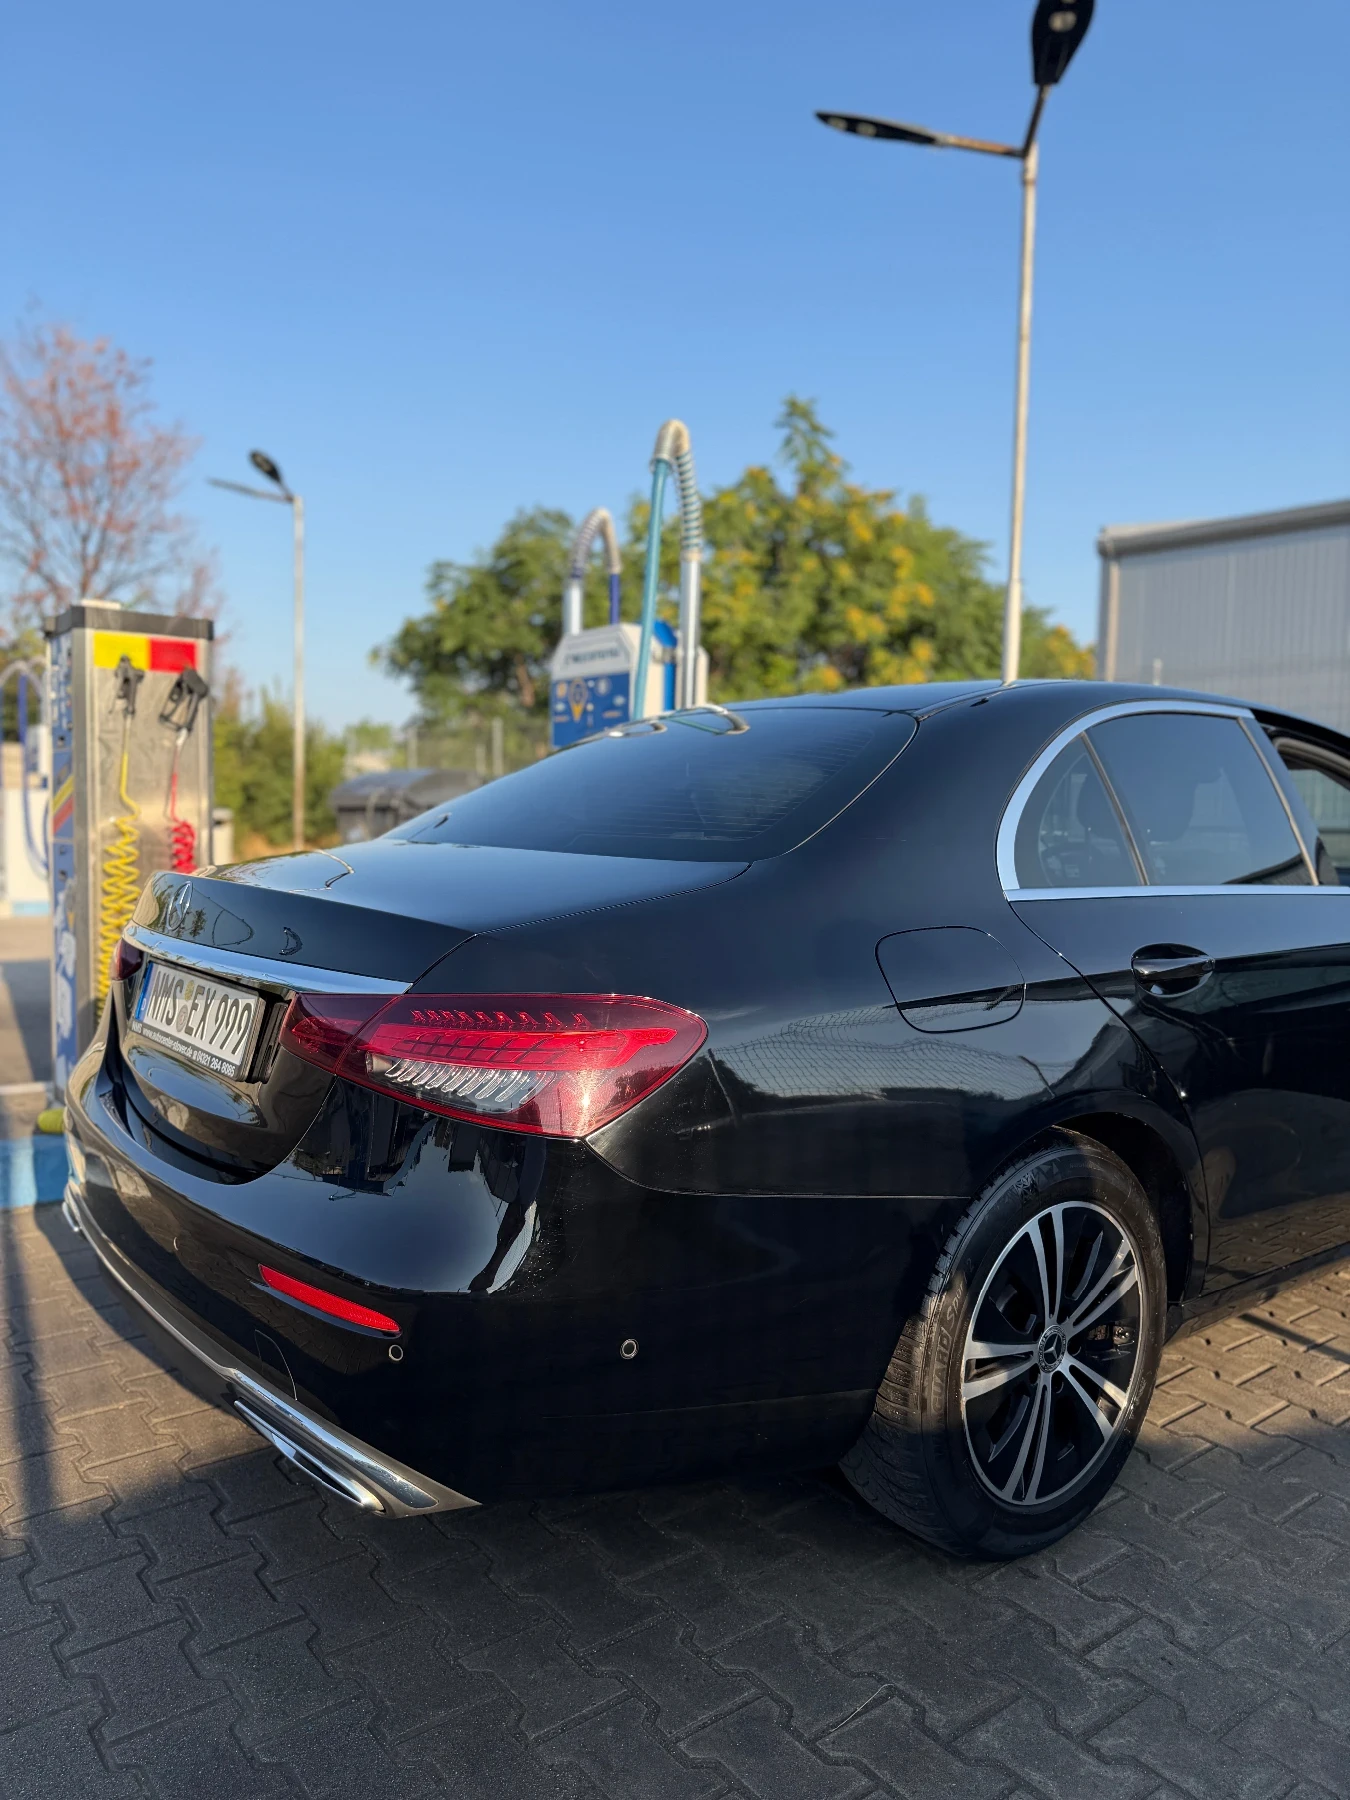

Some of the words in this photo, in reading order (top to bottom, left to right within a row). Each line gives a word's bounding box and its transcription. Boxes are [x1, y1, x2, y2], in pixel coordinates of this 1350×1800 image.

[147, 970, 185, 1026] NMS
[185, 984, 217, 1041] EX
[209, 993, 253, 1056] 999
[210, 1057, 222, 1072] 264
